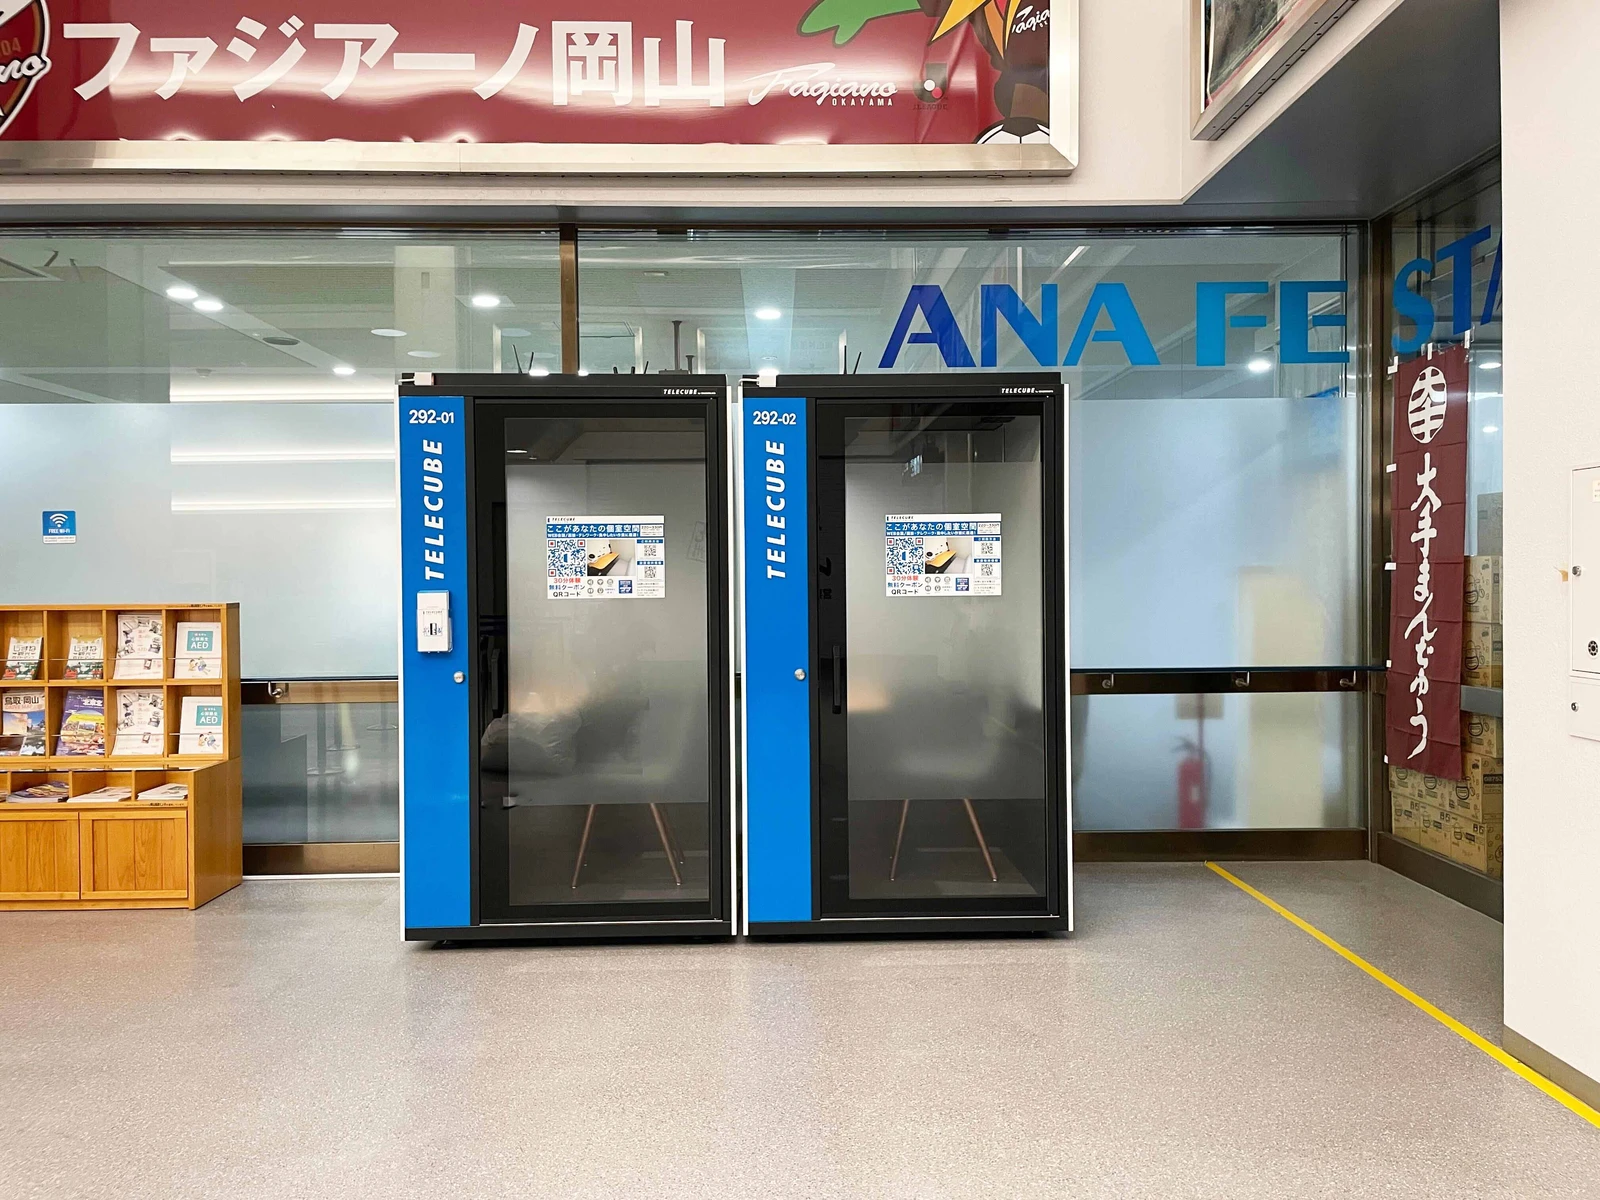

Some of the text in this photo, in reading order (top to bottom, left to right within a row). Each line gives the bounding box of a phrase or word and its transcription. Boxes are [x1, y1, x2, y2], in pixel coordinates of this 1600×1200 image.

[63, 15, 726, 108] ファジアーノ岡山
[742, 62, 898, 106] Fagiano
[831, 98, 893, 107] OKAYAMA
[879, 283, 1161, 368] ANA
[408, 409, 455, 424] 292-01
[752, 410, 797, 425] 292-02
[422, 438, 446, 581] TELECUBE
[765, 440, 787, 580] TELECUBE
[547, 525, 640, 533] ここがあなたの個室空間
[885, 522, 977, 531] ここがあなたの個室空間
[1404, 452, 1443, 760] 大手まんぢゅう
[199, 716, 218, 724] AED
